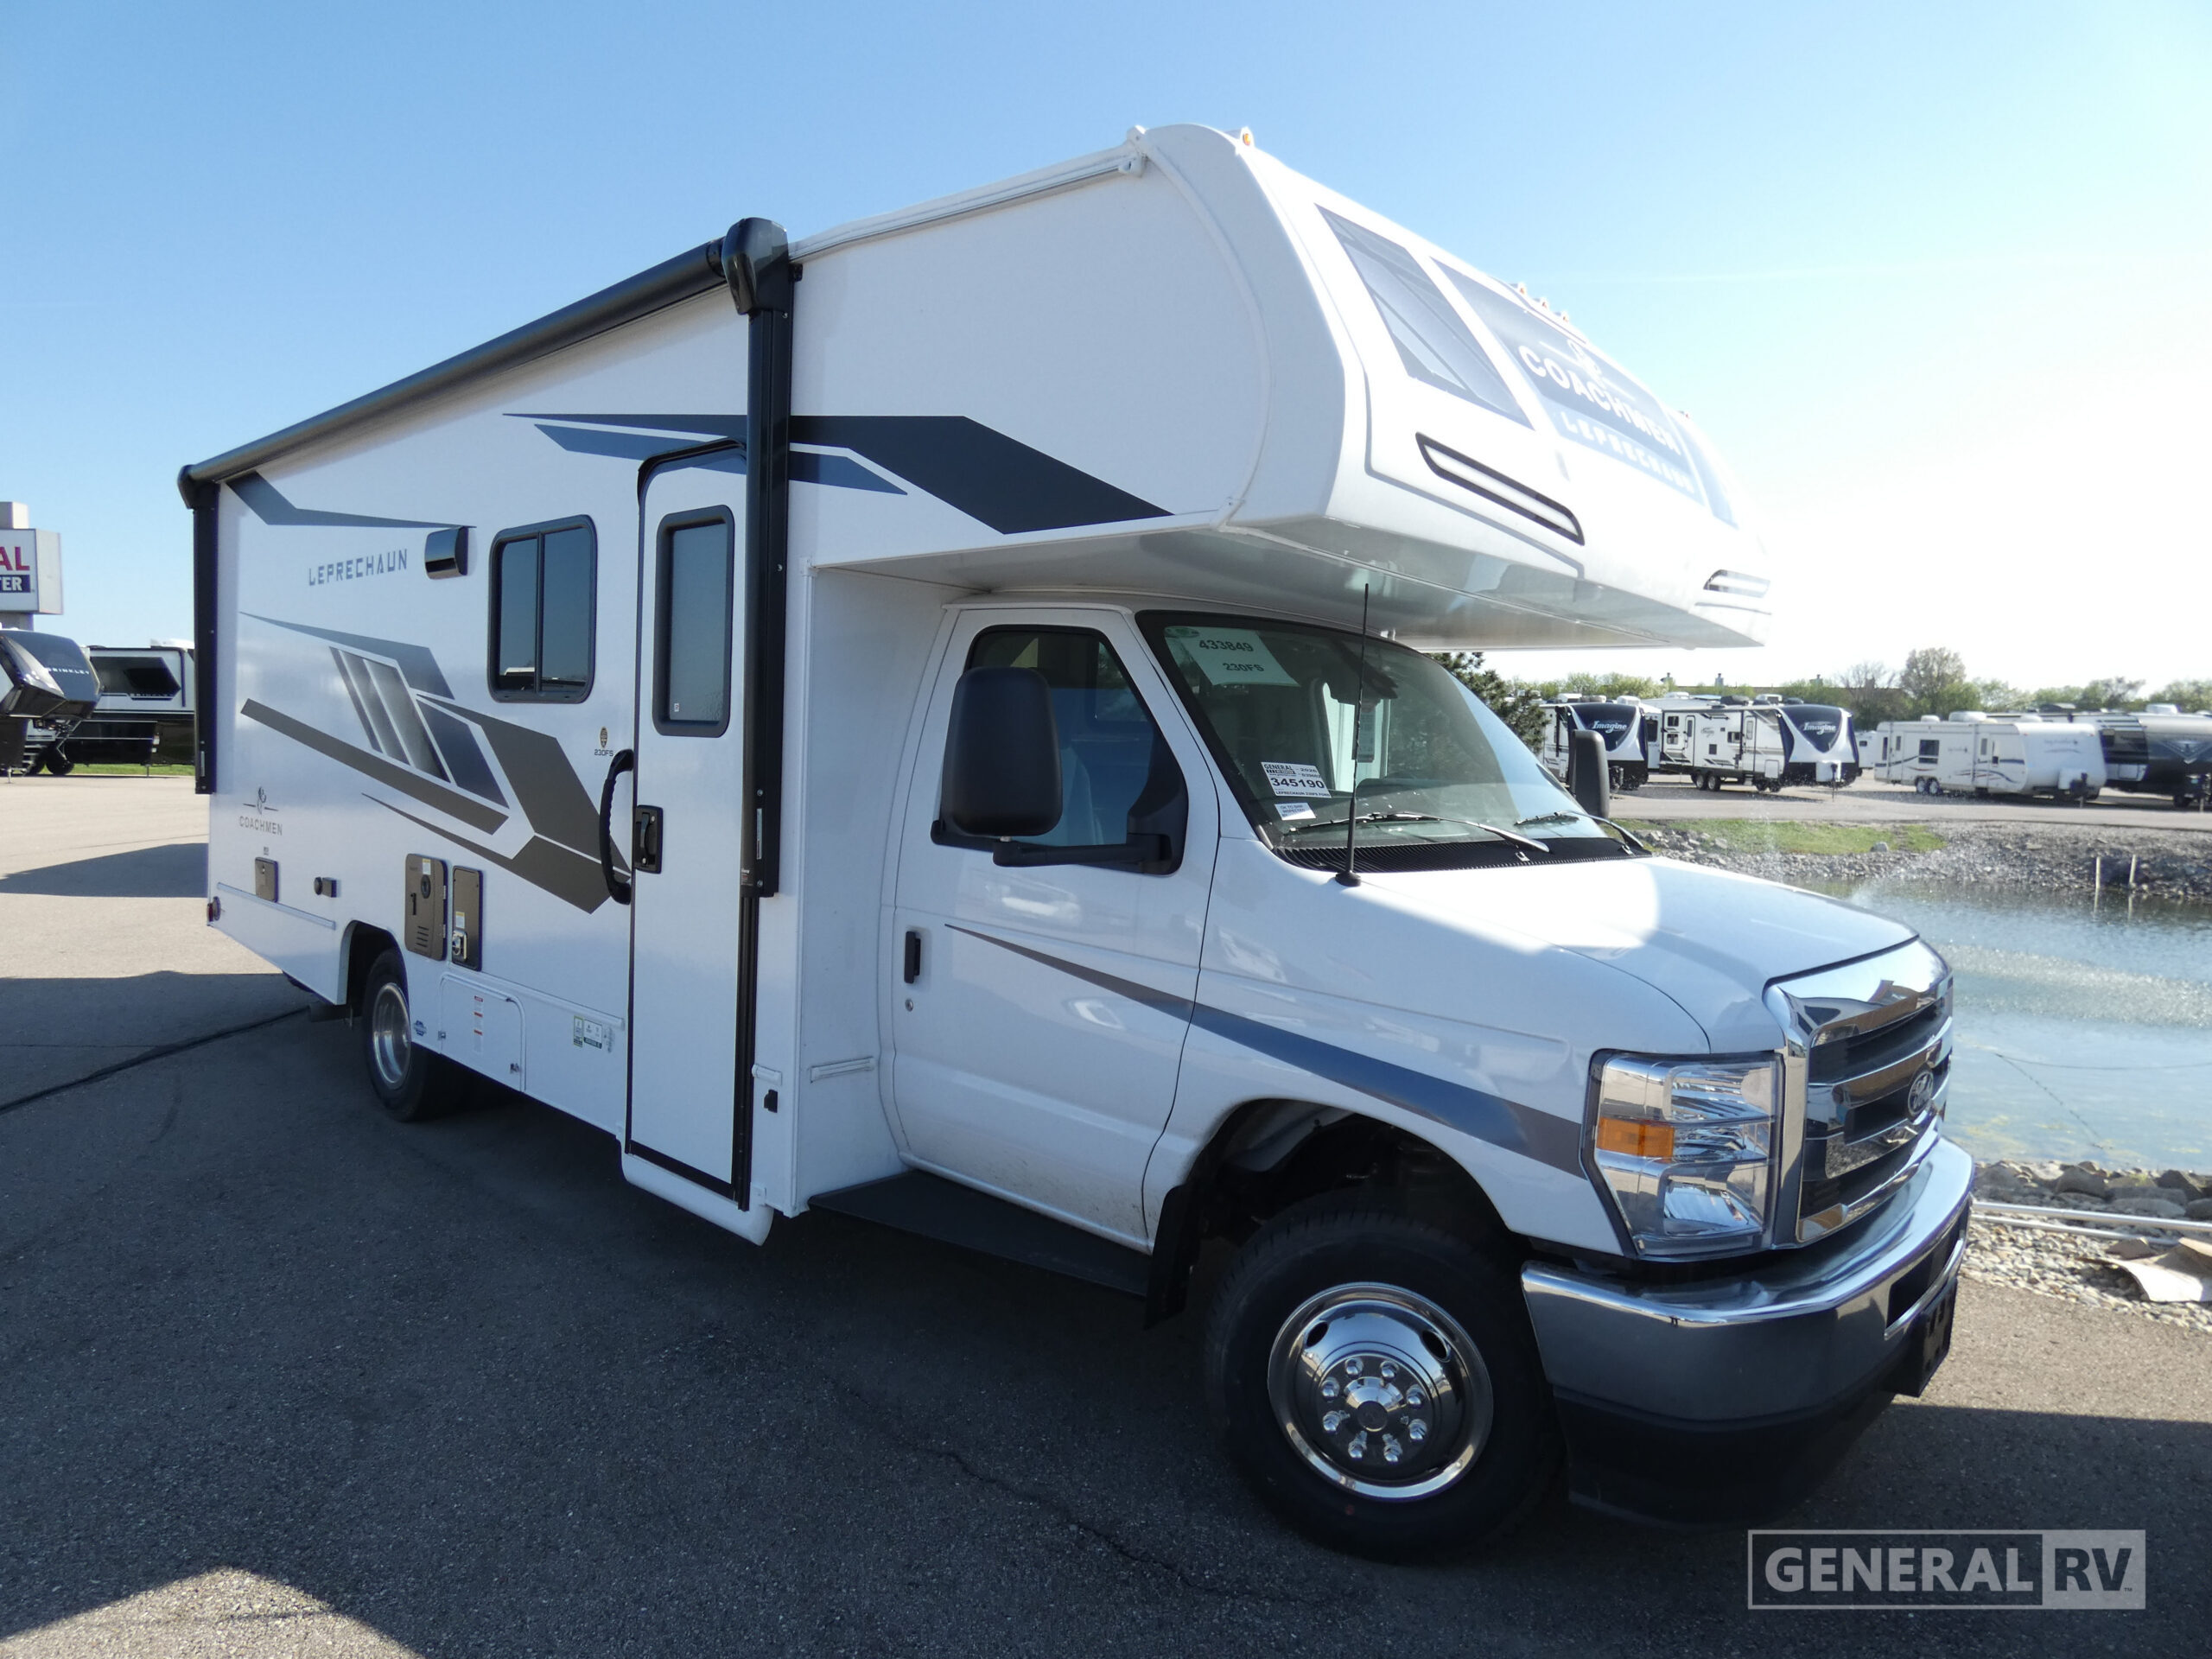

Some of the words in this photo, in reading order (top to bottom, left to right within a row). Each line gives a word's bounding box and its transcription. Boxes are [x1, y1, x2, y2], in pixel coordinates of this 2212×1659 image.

[1518, 345, 1681, 455] COACHMEN
[0, 546, 30, 571] AL
[308, 548, 407, 586] LEPRECHAUN
[0, 575, 22, 591] ER
[1198, 639, 1255, 652] 433849
[1222, 662, 1265, 672] 230FS
[1592, 720, 1628, 734] Imagine
[1803, 721, 1837, 735] Imagine
[594, 748, 614, 757] 230FS
[1270, 778, 1325, 788] 345190
[239, 815, 283, 836] COACHMEN
